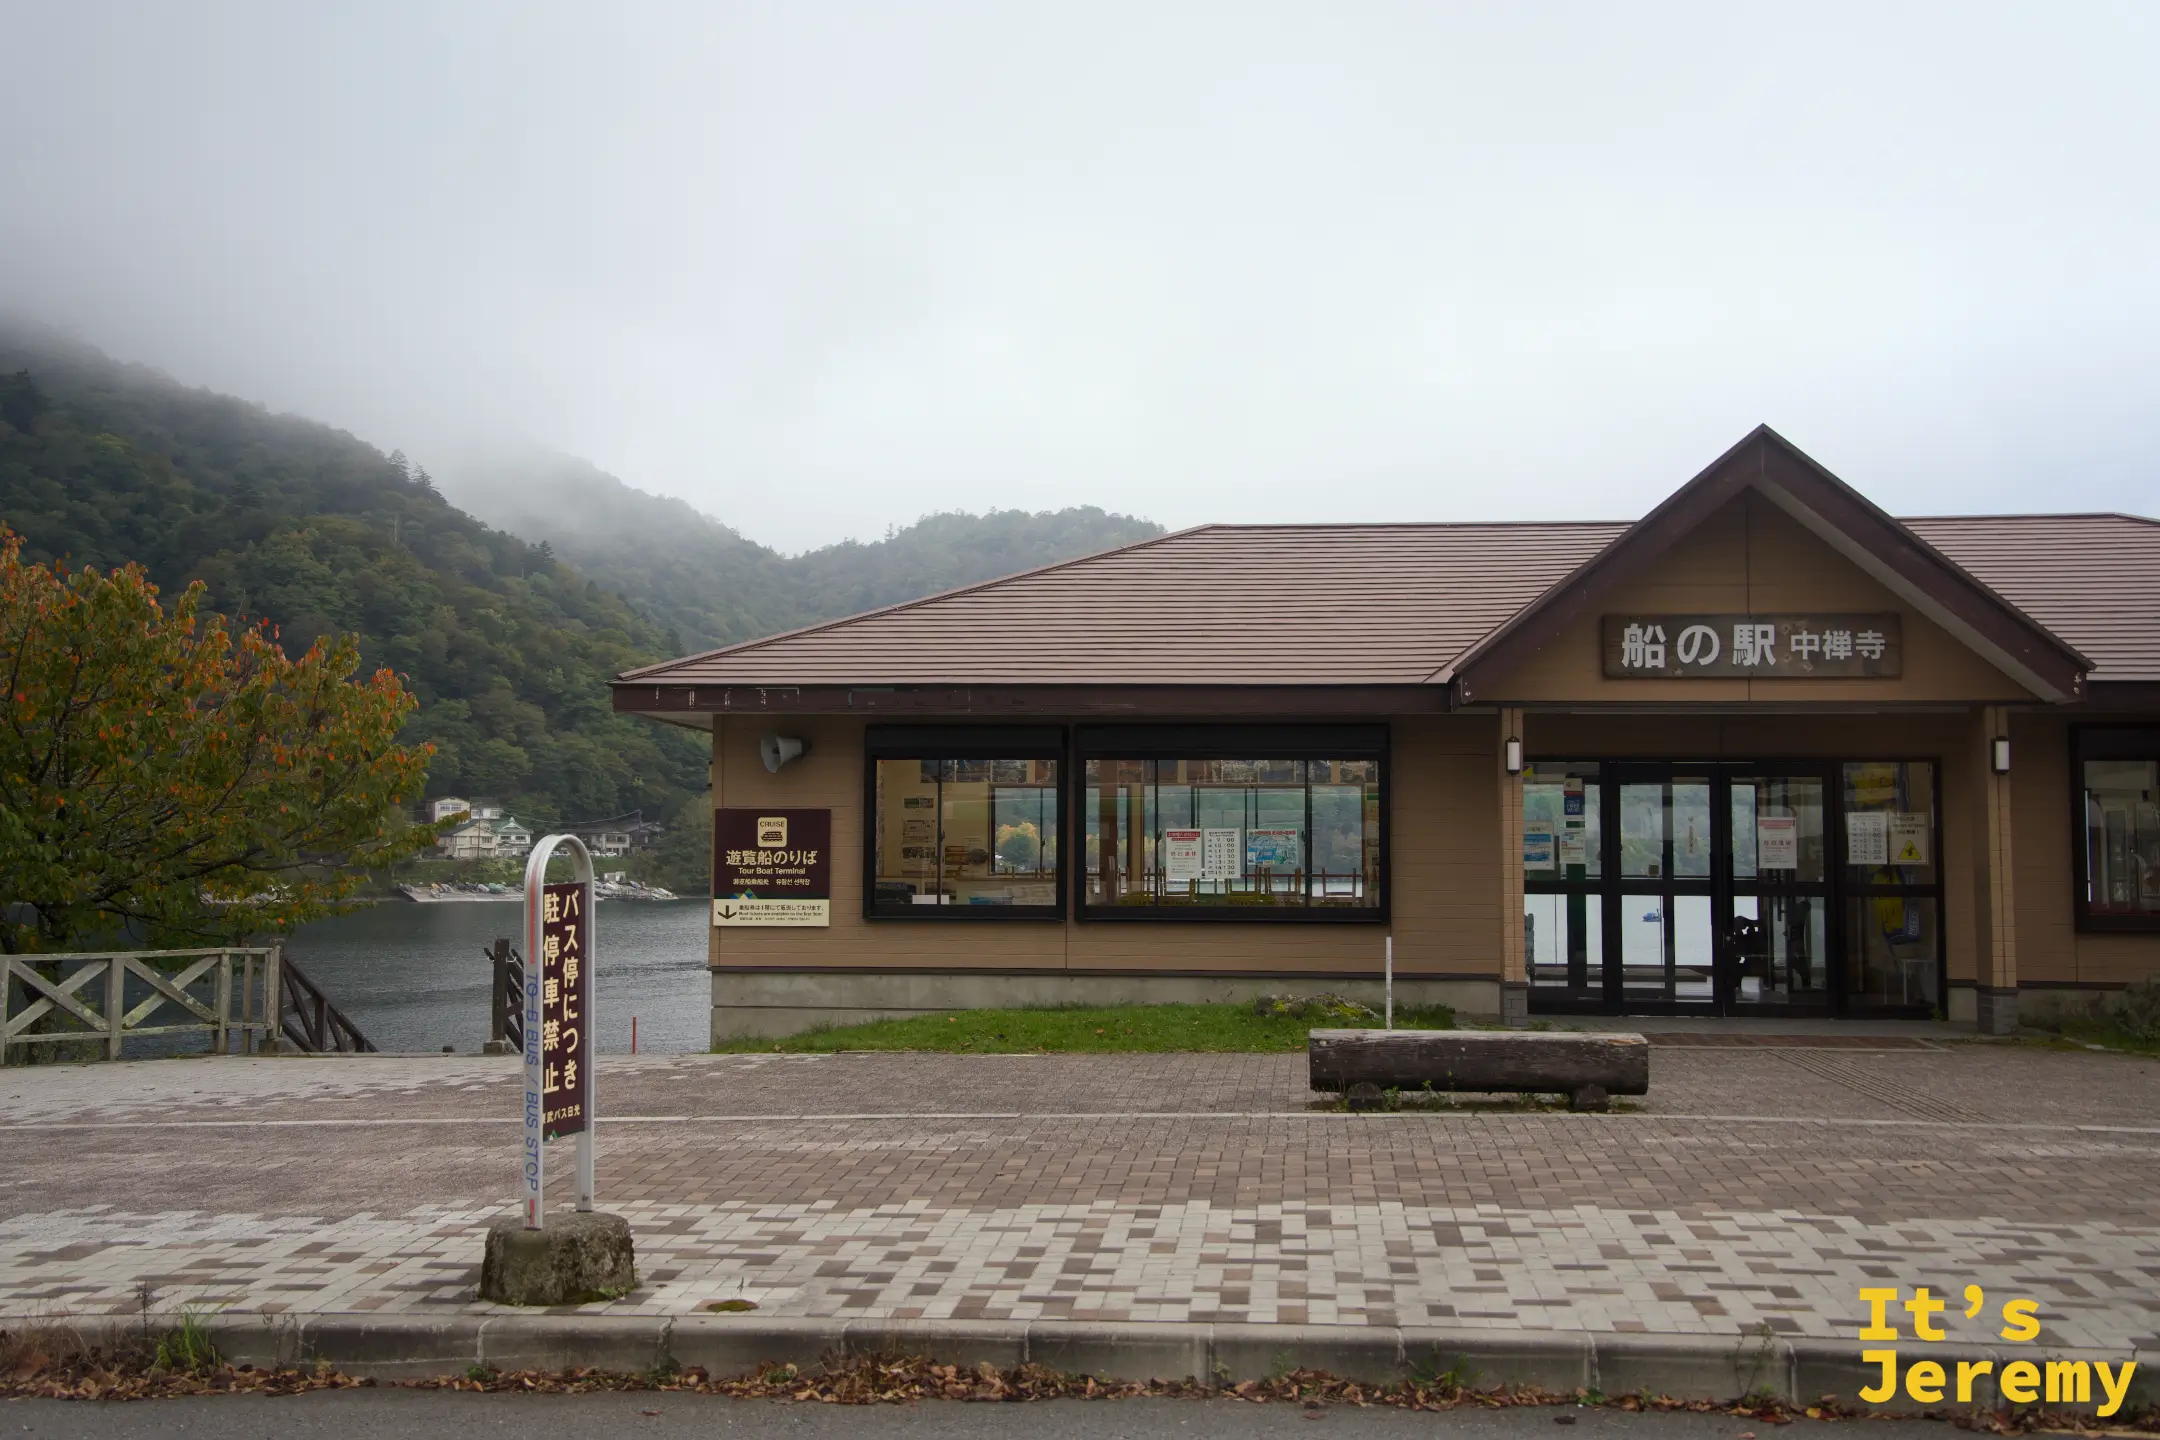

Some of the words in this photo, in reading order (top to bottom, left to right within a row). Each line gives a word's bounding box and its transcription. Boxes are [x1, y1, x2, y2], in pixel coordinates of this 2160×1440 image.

[1621, 623, 1776, 669] 船の駅
[1790, 629, 1886, 660] 中禅寺
[759, 820, 785, 828] CRUISE
[726, 849, 818, 866] 遊覧船のりば
[738, 867, 754, 875] Tour
[756, 867, 773, 875] Boat
[775, 867, 806, 875] Terminal
[543, 892, 560, 1094] 駐停車禁止
[562, 889, 580, 1090] バス停につき
[526, 1028, 539, 1066] BUS
[526, 1091, 539, 1129] BUS
[525, 1136, 538, 1191] STOP
